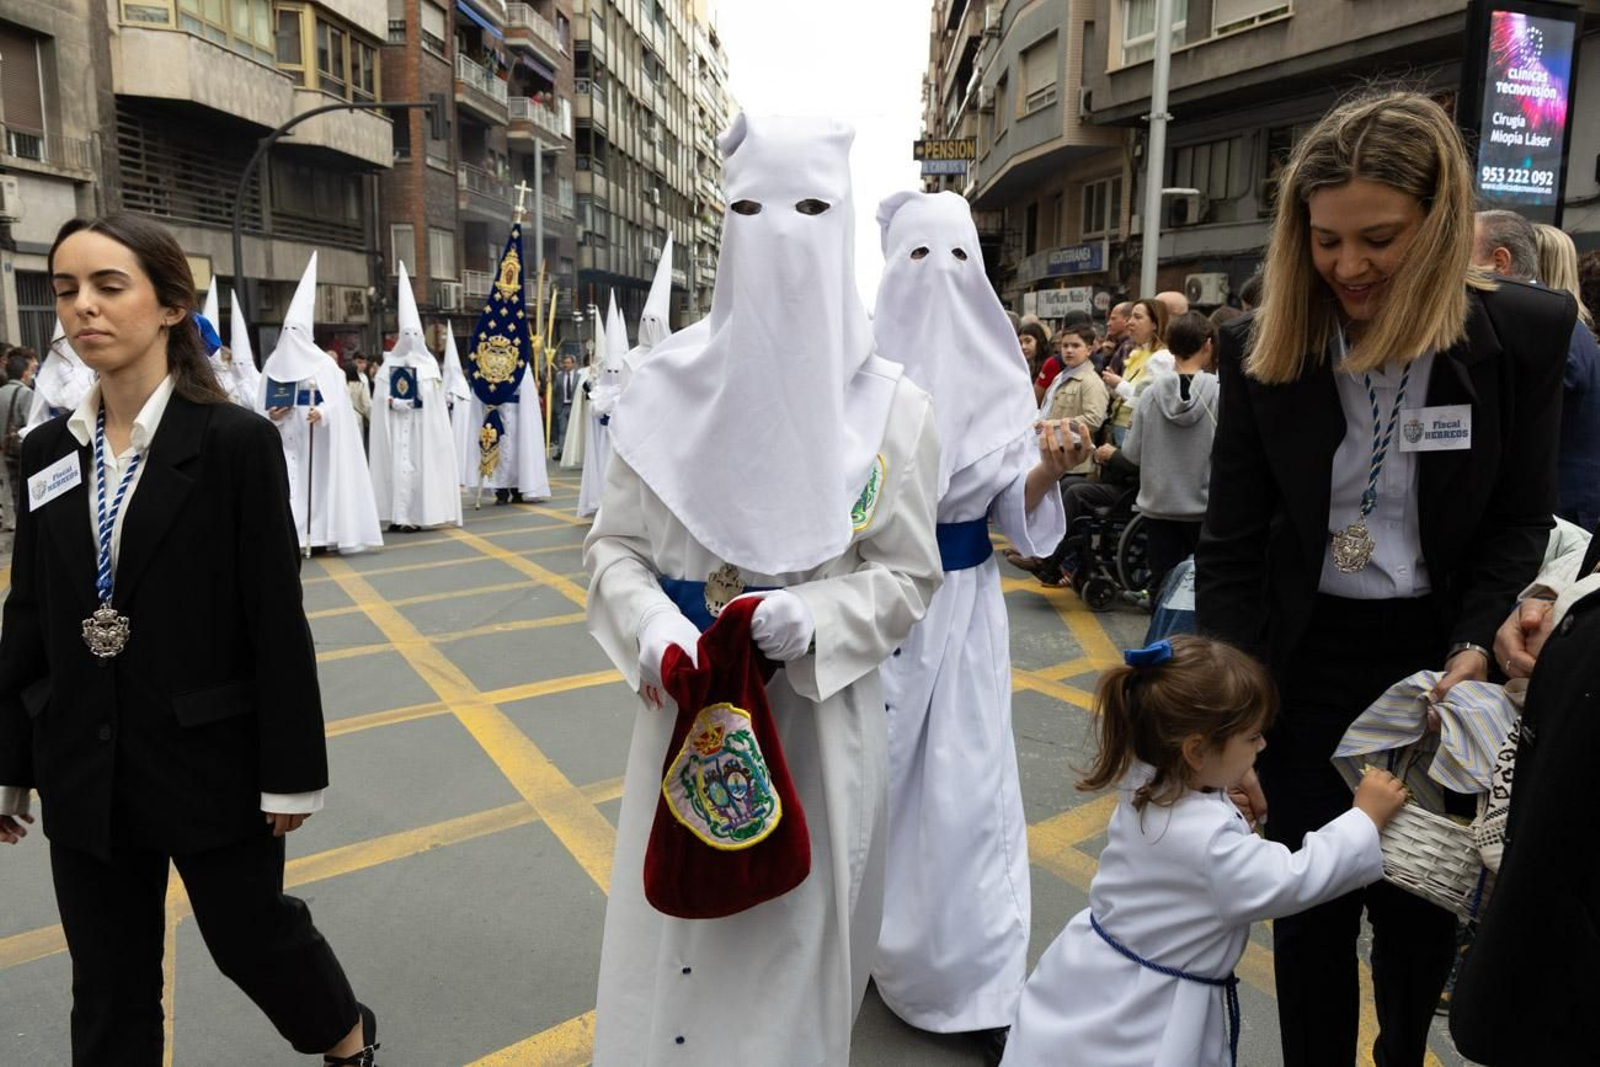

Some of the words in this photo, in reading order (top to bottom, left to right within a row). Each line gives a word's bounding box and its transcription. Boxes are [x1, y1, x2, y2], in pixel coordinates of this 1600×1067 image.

[1492, 112, 1526, 130] Cirugía
[1490, 129, 1523, 147] Miopía
[1525, 132, 1552, 148] Láser
[925, 141, 975, 159] PENSION
[1482, 166, 1505, 182] 953
[1507, 168, 1530, 184] 222
[1531, 170, 1554, 186] 092
[1433, 420, 1461, 429] Fiscal
